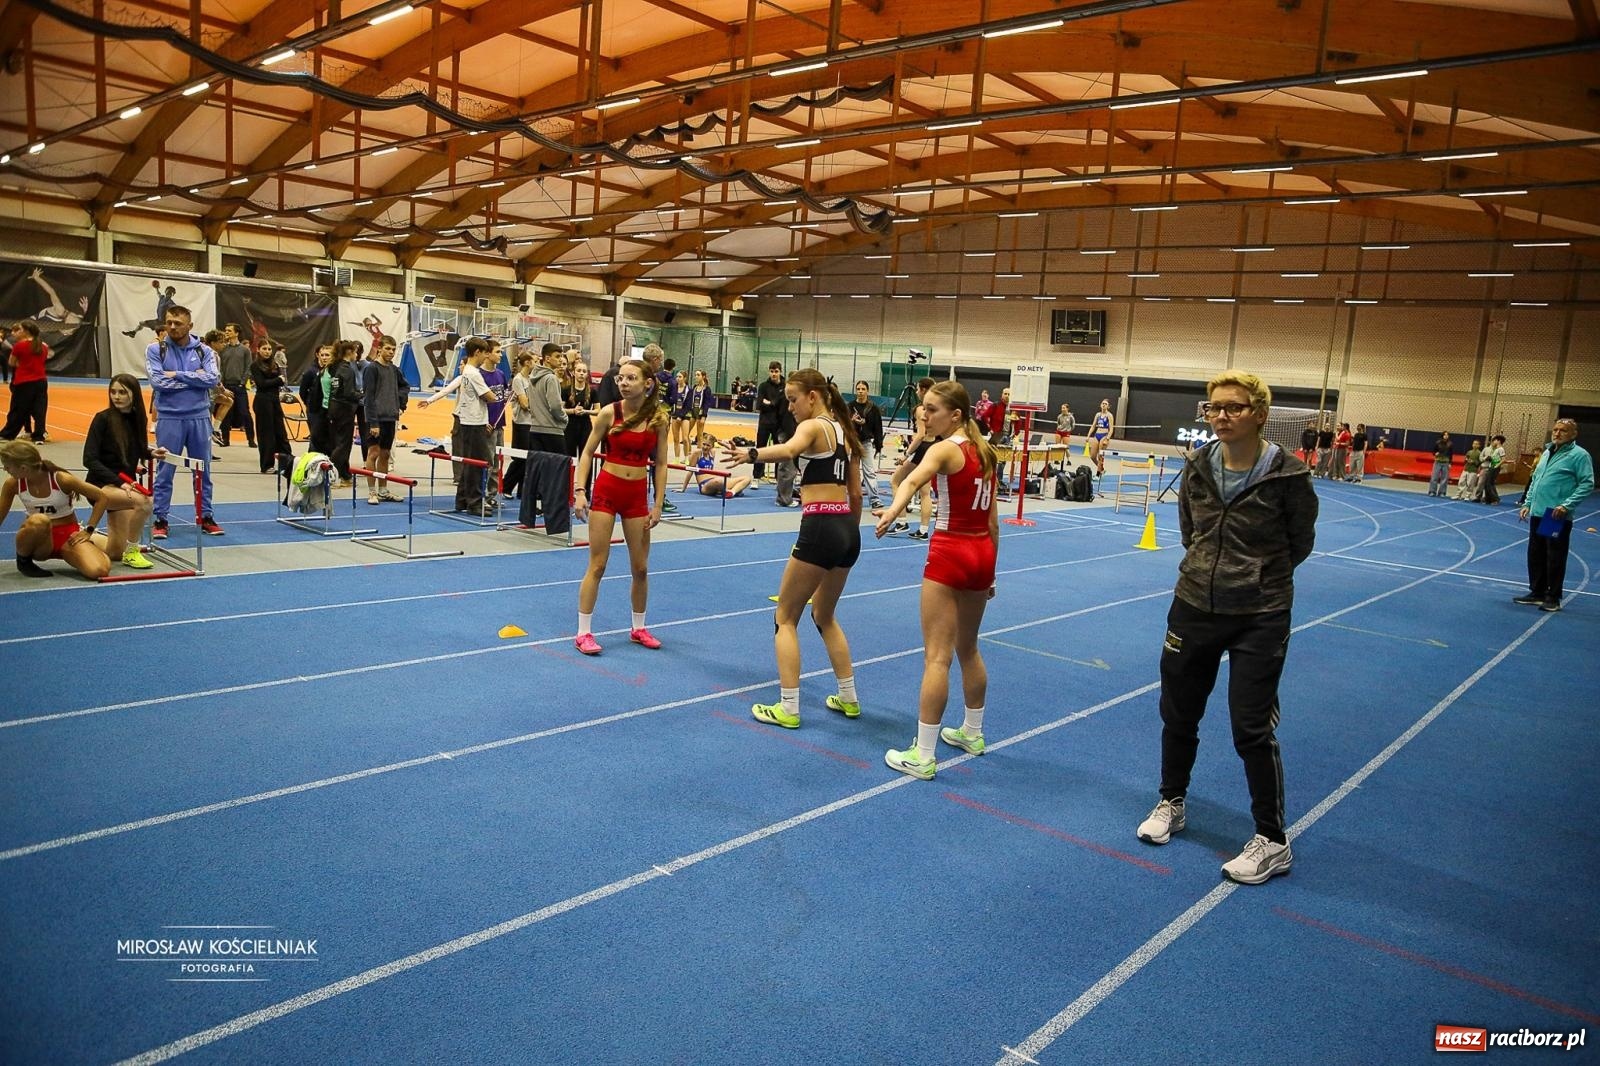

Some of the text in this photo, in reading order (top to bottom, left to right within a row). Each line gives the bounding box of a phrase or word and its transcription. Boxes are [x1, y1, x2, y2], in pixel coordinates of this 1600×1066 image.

[833, 458, 845, 480] 41
[971, 477, 991, 511] 78
[820, 503, 842, 511] PRO
